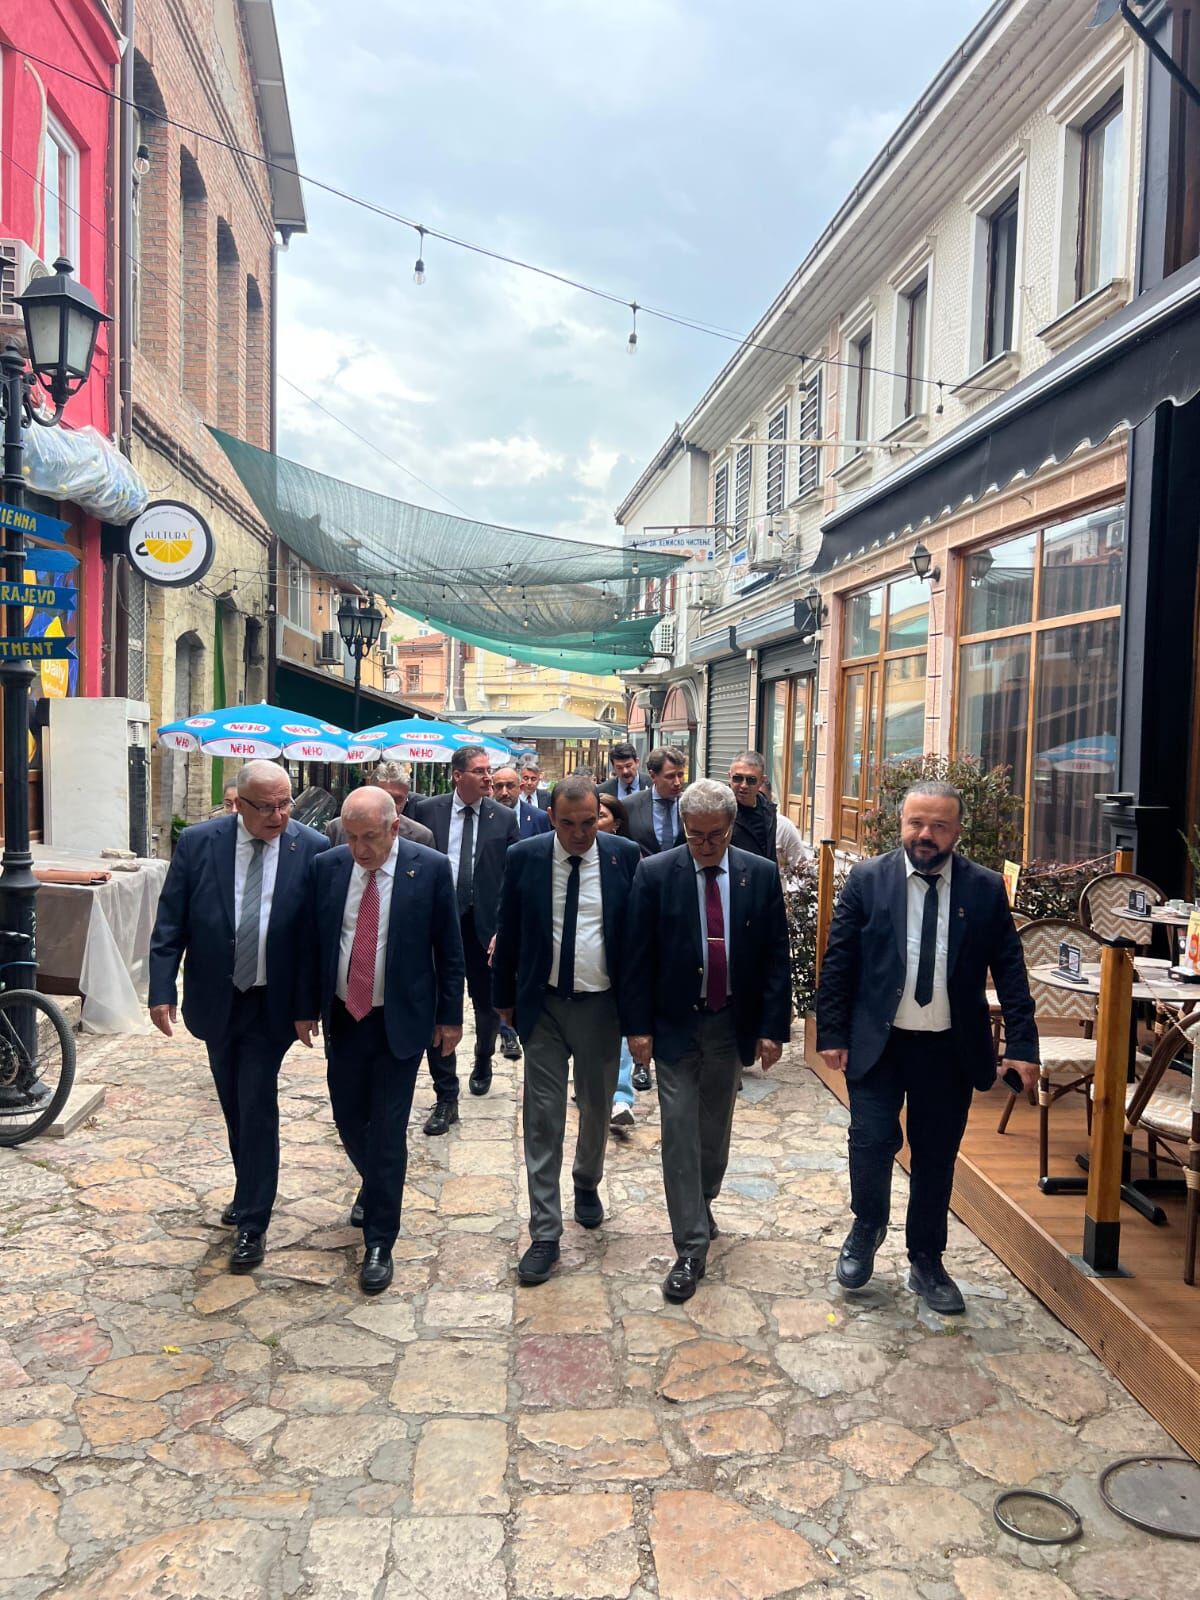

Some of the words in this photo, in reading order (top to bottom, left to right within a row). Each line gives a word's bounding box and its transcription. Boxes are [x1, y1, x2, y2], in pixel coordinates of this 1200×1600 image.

[0, 506, 37, 532] IENNA
[144, 530, 187, 540] KULTURA
[1, 585, 56, 605] RAJEVO
